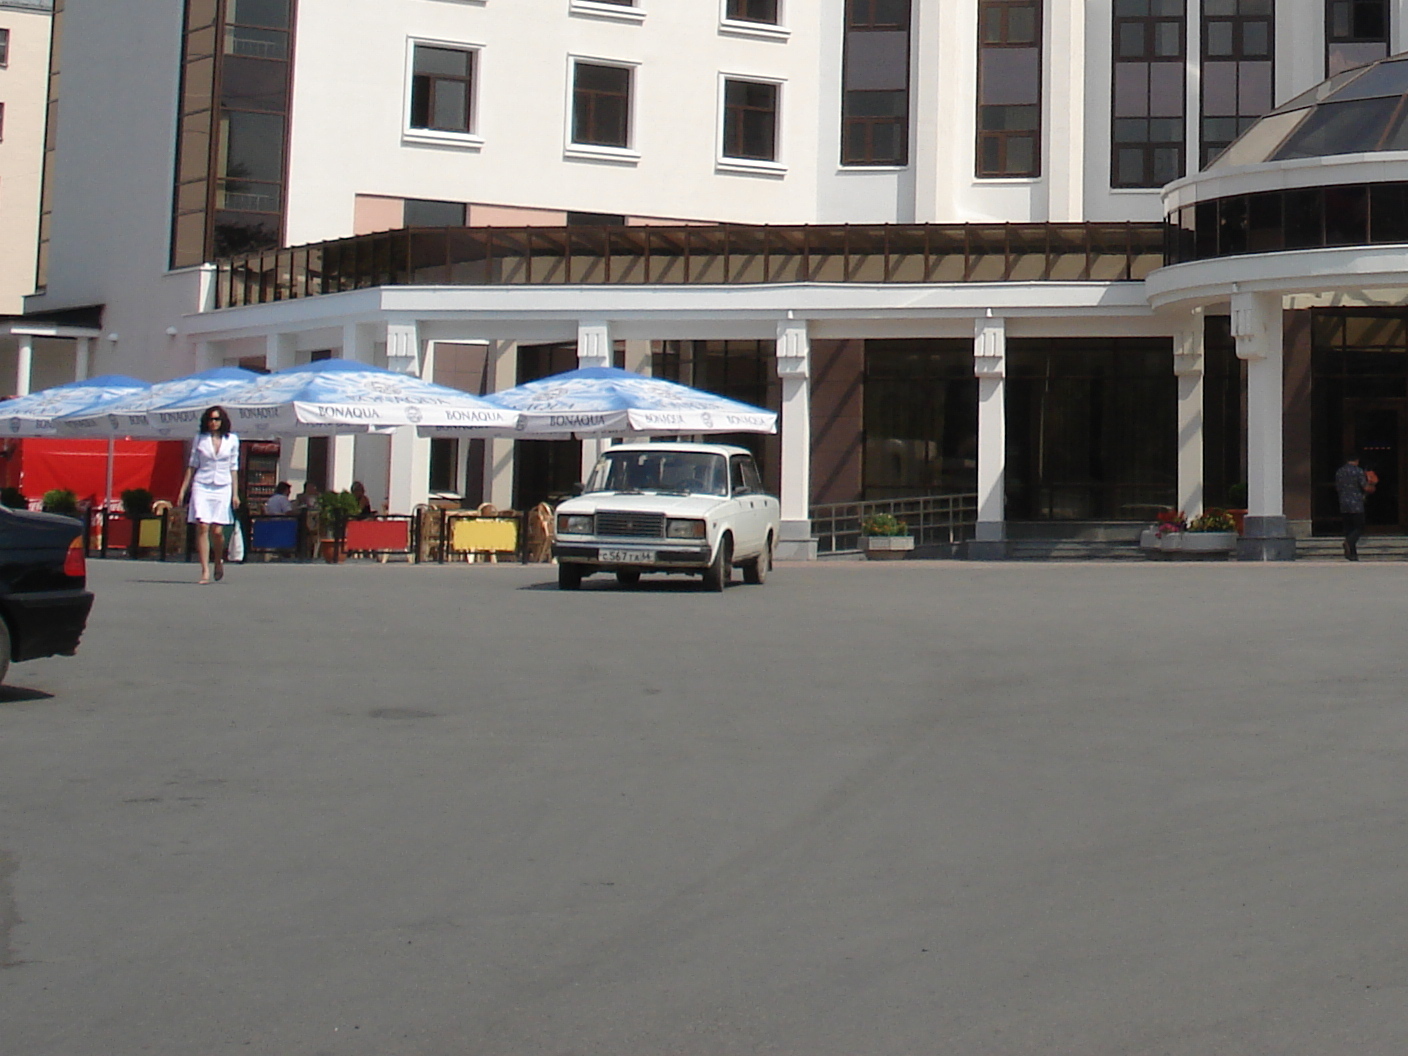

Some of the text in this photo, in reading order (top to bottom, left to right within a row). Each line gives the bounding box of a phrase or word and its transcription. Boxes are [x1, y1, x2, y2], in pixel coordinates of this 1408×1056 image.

[318, 405, 381, 419] BONAQUA
[446, 409, 504, 422] BONAQUA
[549, 414, 606, 427] BONAQUA
